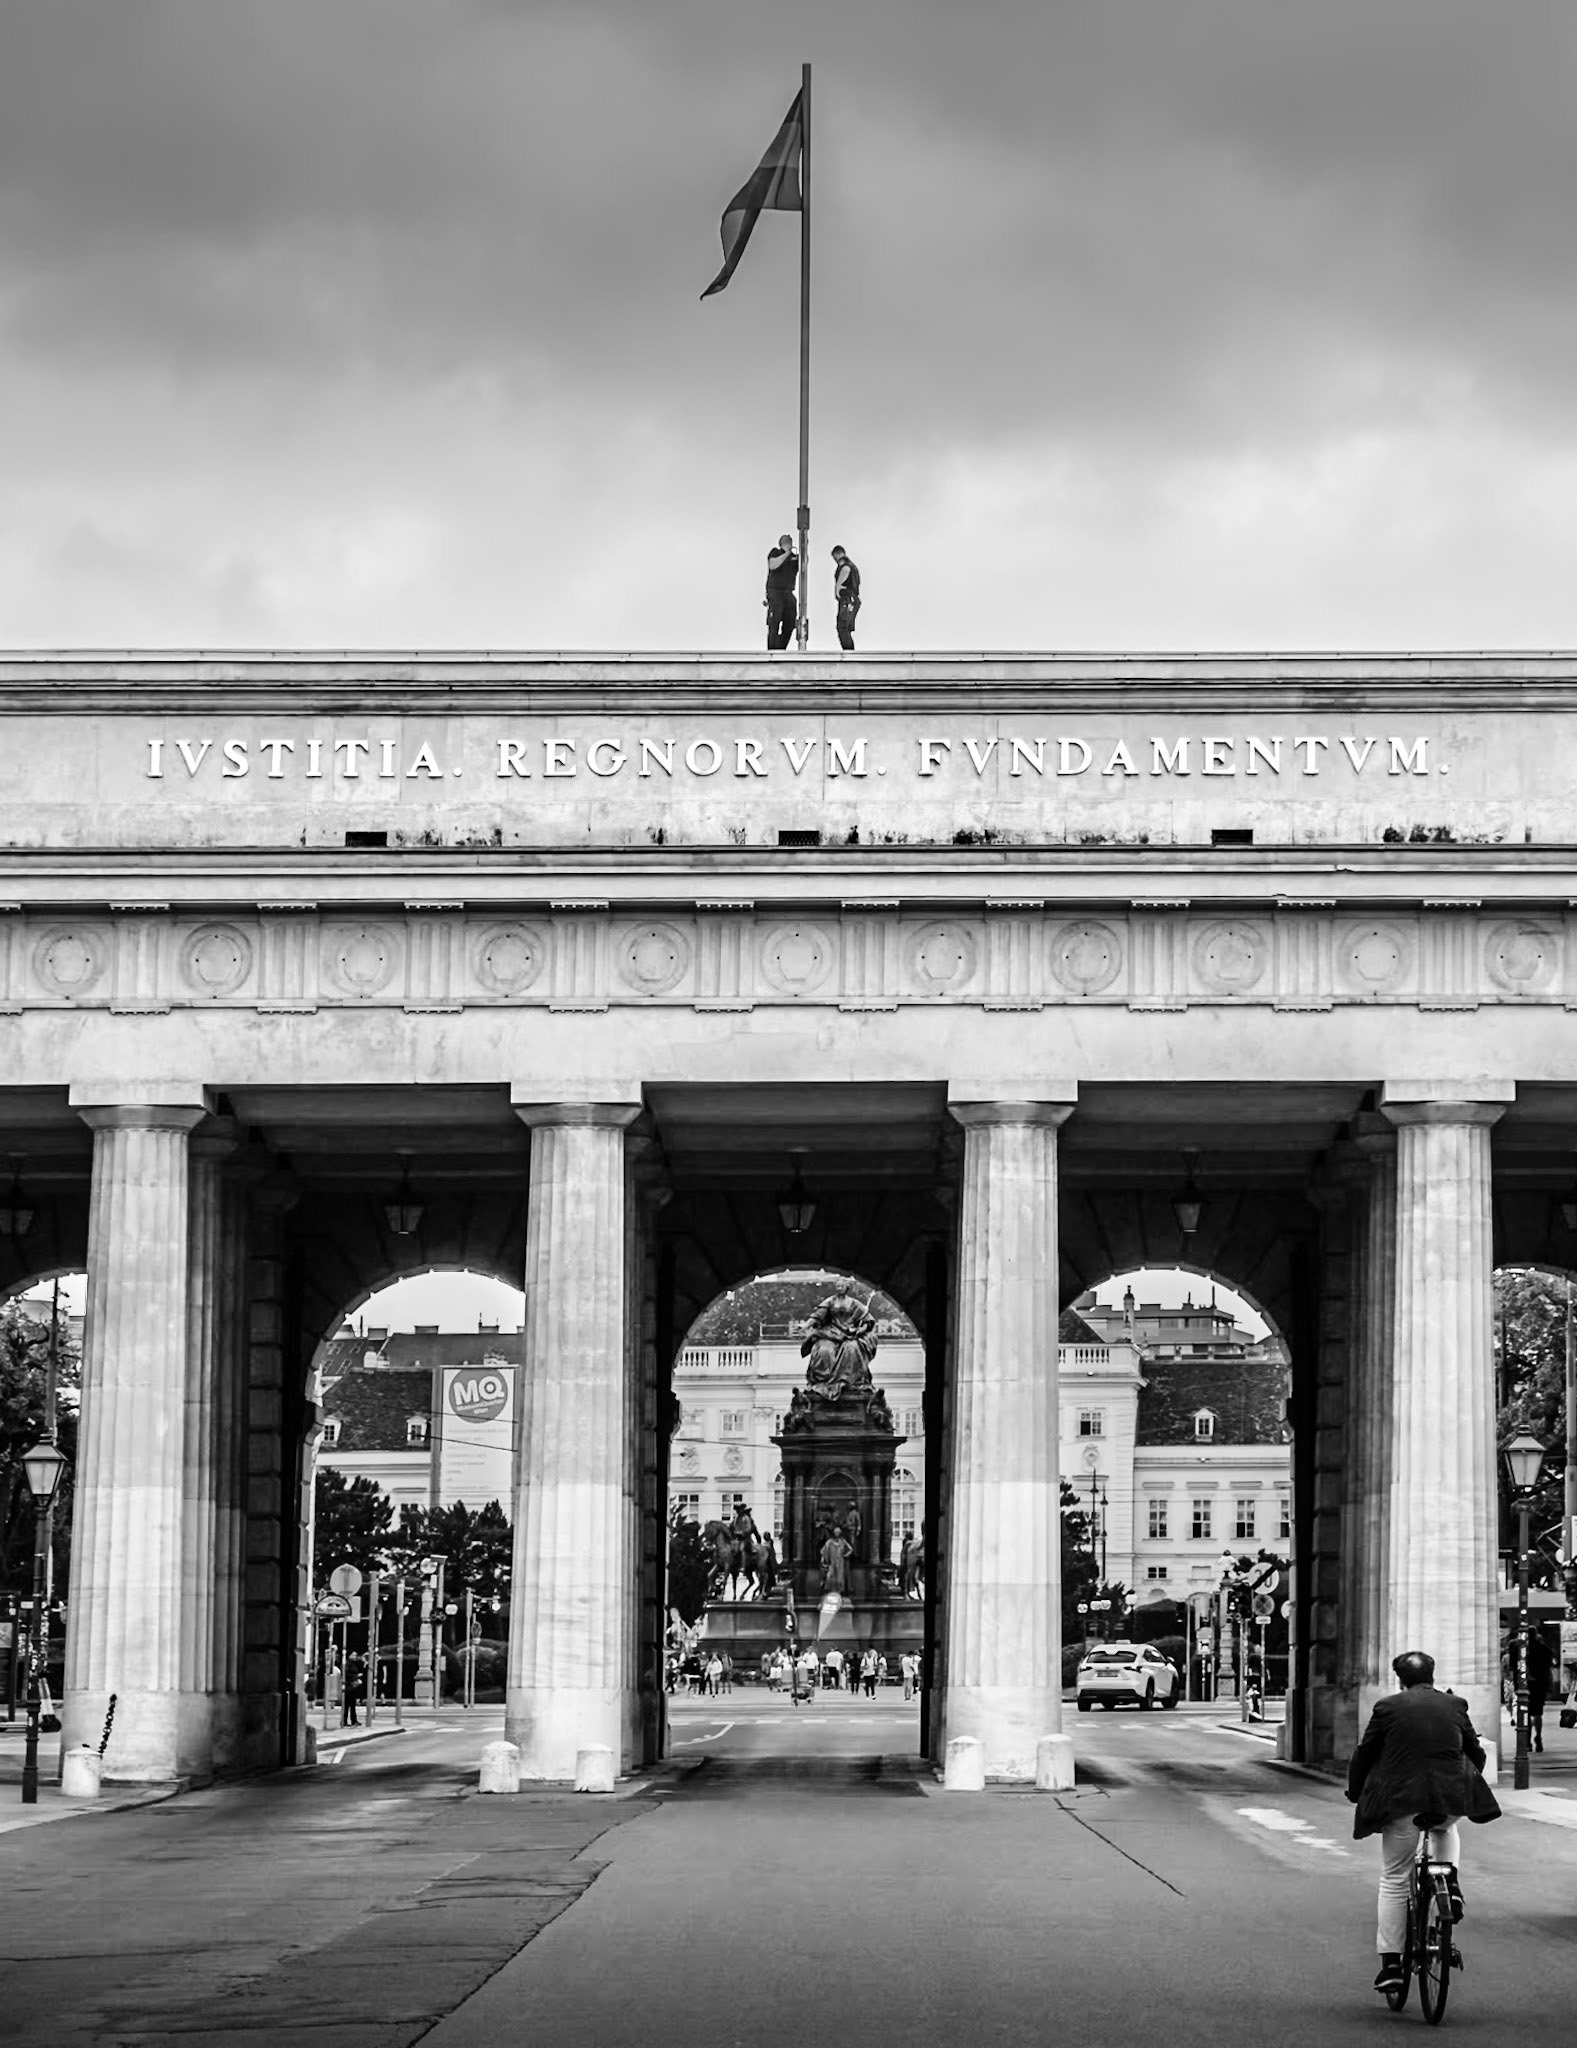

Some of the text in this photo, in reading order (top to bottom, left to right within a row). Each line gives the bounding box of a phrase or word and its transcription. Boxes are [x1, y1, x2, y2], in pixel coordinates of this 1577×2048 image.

[146, 736, 1450, 779] IVSTITIA. REGNORVM. FVNDAMENTVM.
[453, 1376, 505, 1405] MQ
